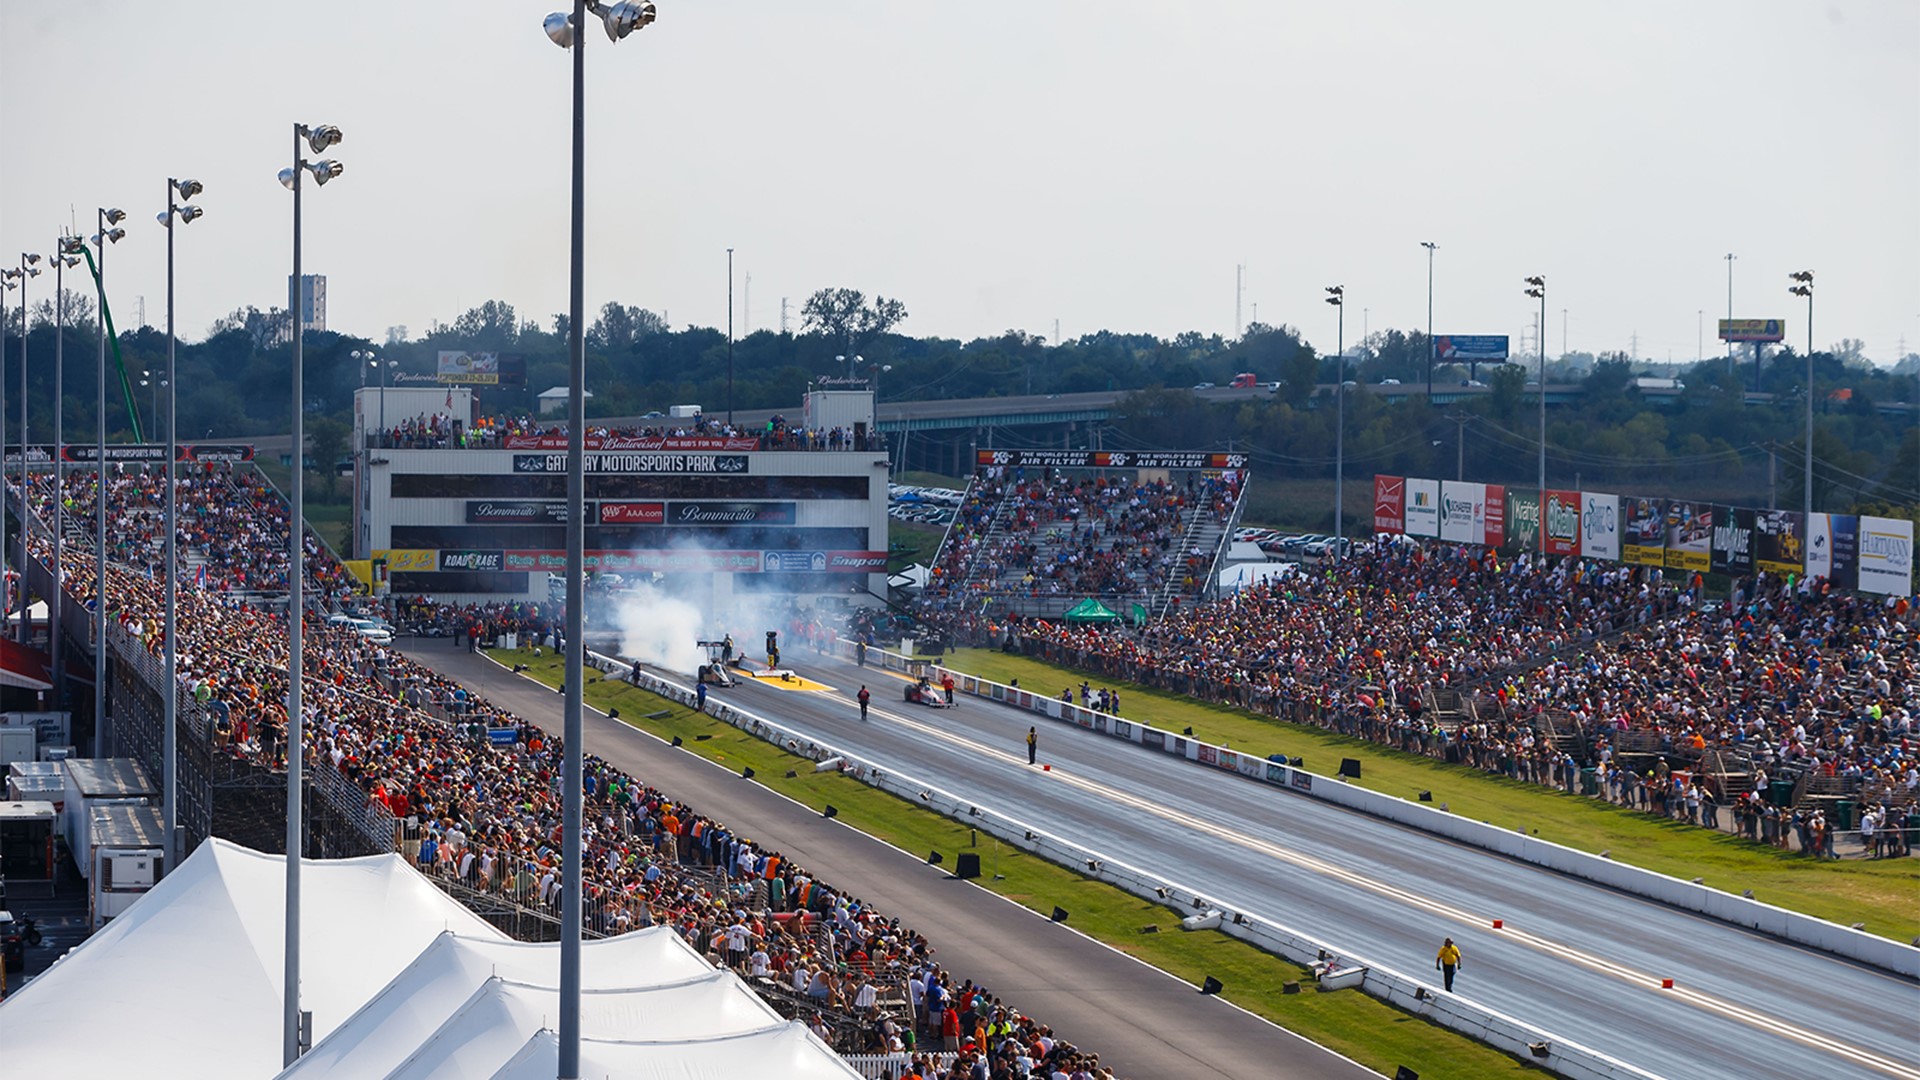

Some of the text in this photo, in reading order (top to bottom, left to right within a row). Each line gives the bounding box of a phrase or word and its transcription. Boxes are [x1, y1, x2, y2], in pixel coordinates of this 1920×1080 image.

[392, 372, 448, 383] Budweiser
[816, 375, 869, 385] Budweiser
[604, 438, 661, 450] Budweiser
[546, 455, 717, 472] GATAY MOTORSPORTS PARK
[475, 503, 536, 516] Bommarito
[626, 509, 663, 518] AAA.com
[444, 554, 468, 566] ROAD
[475, 554, 498, 566] RAGE
[830, 556, 887, 567] Snap-on
